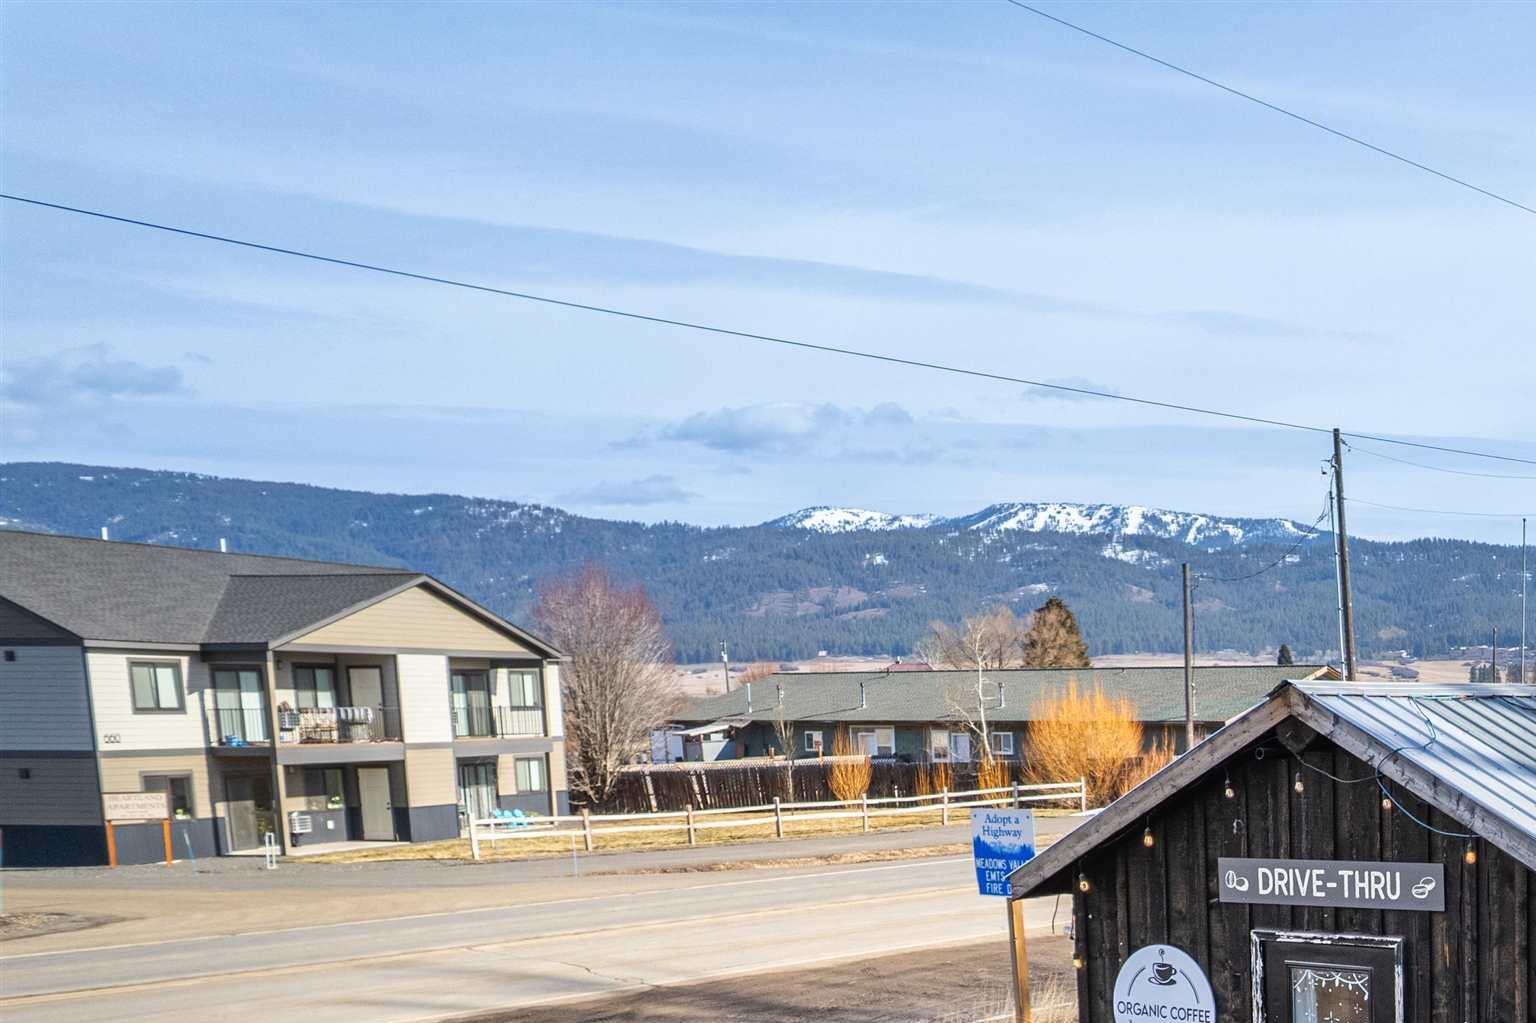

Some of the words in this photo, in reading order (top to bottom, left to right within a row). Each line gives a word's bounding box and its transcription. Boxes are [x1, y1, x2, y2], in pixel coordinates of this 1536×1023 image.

[984, 813, 1012, 826] Adopt
[982, 825, 1022, 839] Highway
[986, 882, 1003, 895] FIRE
[1257, 867, 1401, 900] DRIVE-THRU
[1117, 1001, 1168, 1019] ORGANIC
[1170, 1006, 1211, 1023] COFFEE
